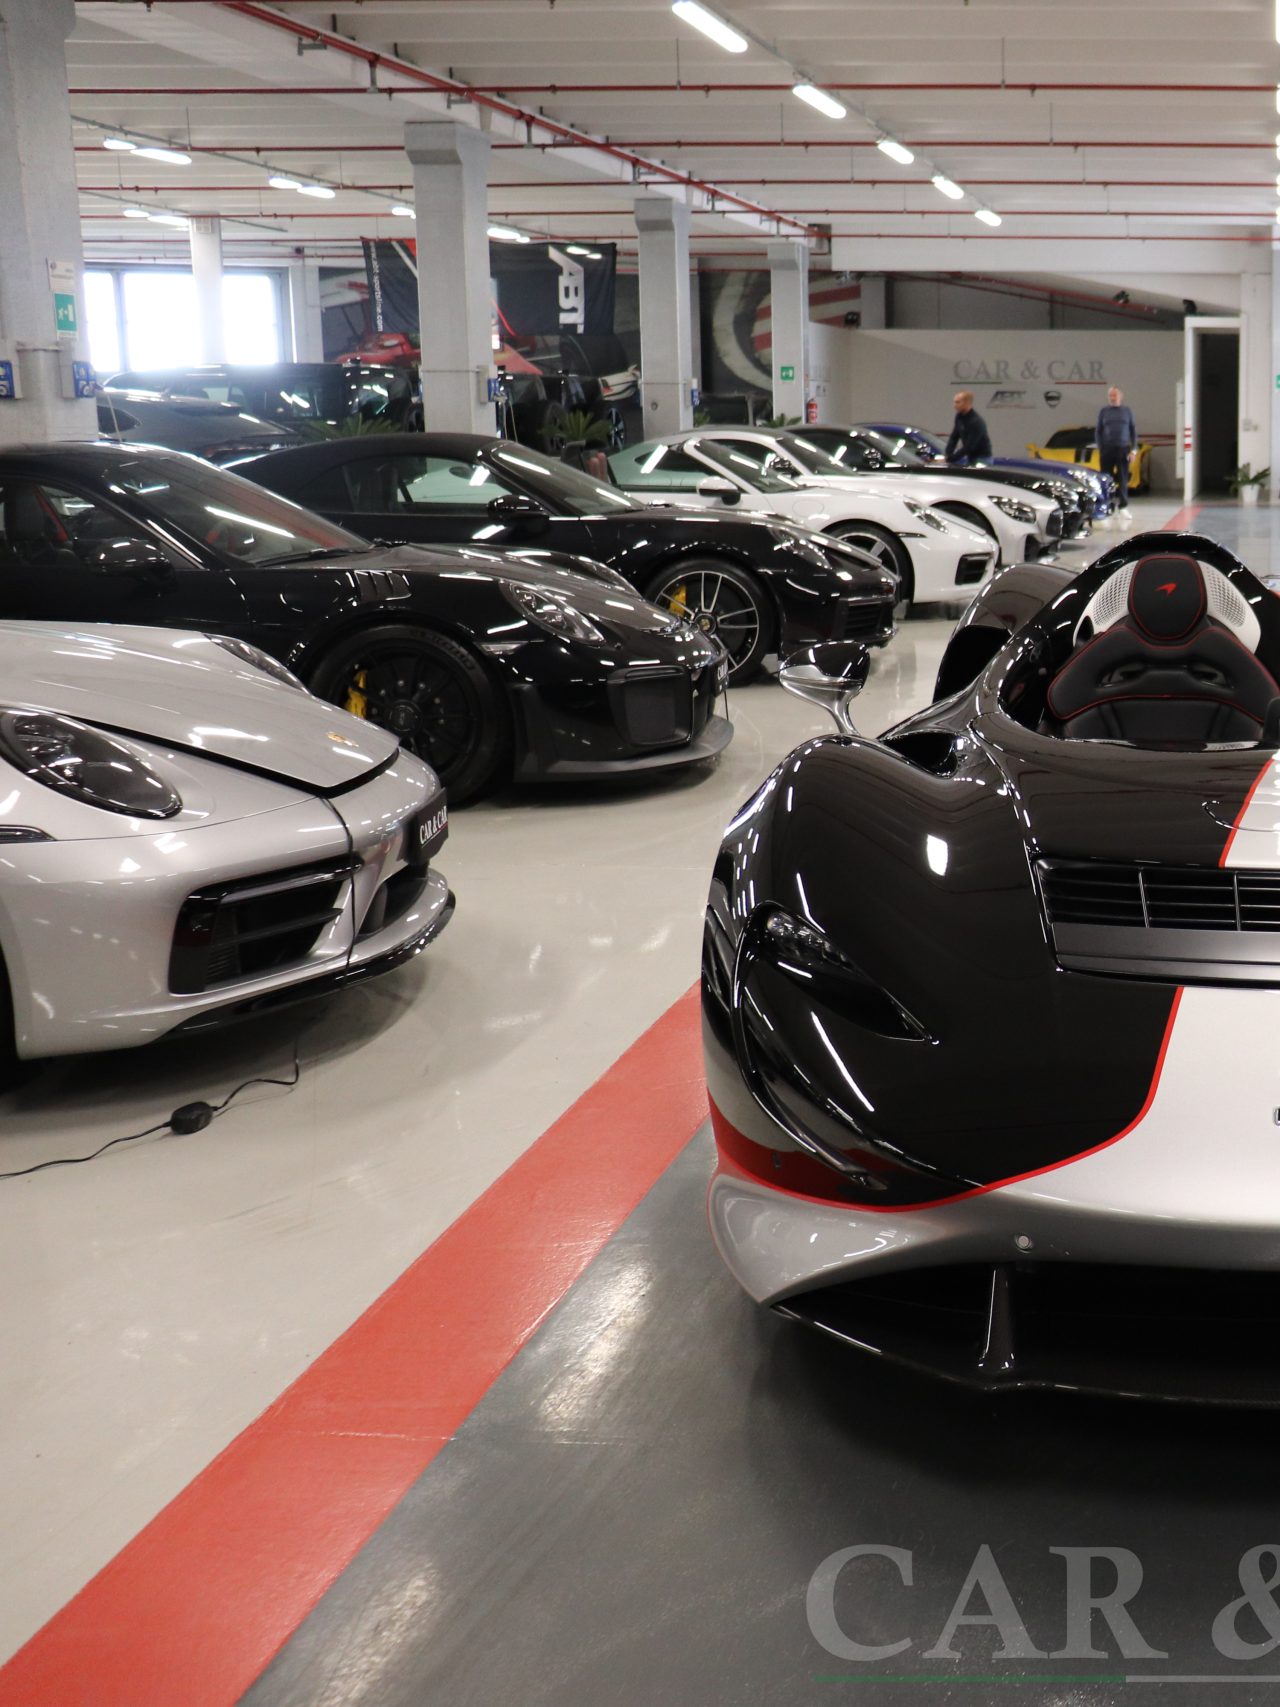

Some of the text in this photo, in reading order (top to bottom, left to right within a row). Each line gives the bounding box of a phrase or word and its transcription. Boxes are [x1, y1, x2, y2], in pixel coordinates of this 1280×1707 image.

[548, 245, 585, 334] ABT
[953, 359, 1104, 380] CAR & CAR
[420, 819, 433, 845] CAR
